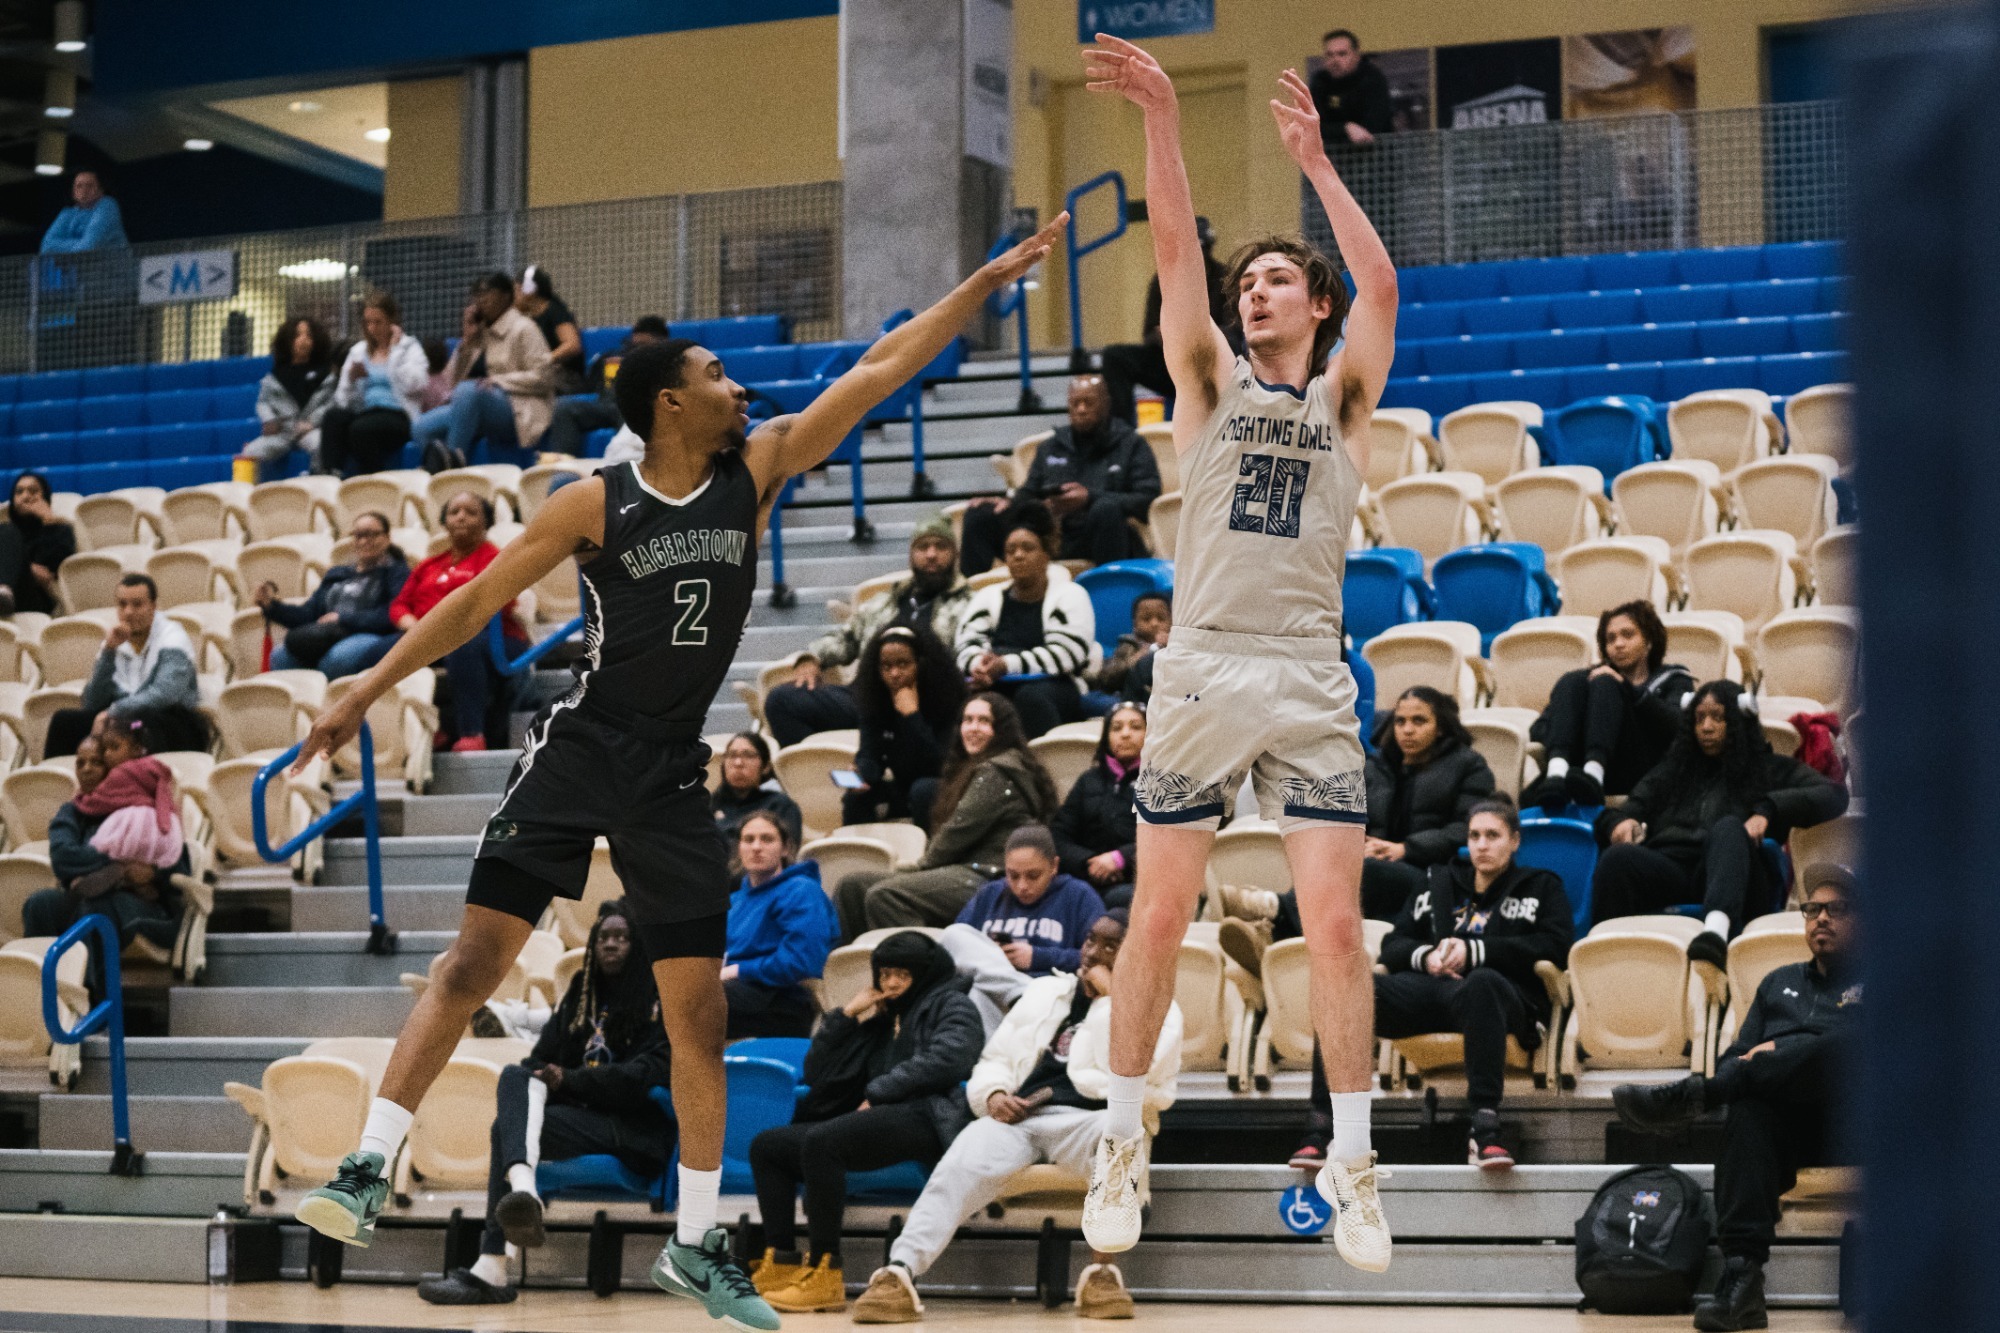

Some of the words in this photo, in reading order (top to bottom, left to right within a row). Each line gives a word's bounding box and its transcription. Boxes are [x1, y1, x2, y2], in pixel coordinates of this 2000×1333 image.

[1103, 0, 1209, 28] WOMEN
[1229, 453, 1311, 539] 20
[620, 529, 749, 580] HAGERSTOWN
[671, 578, 711, 646] 2
